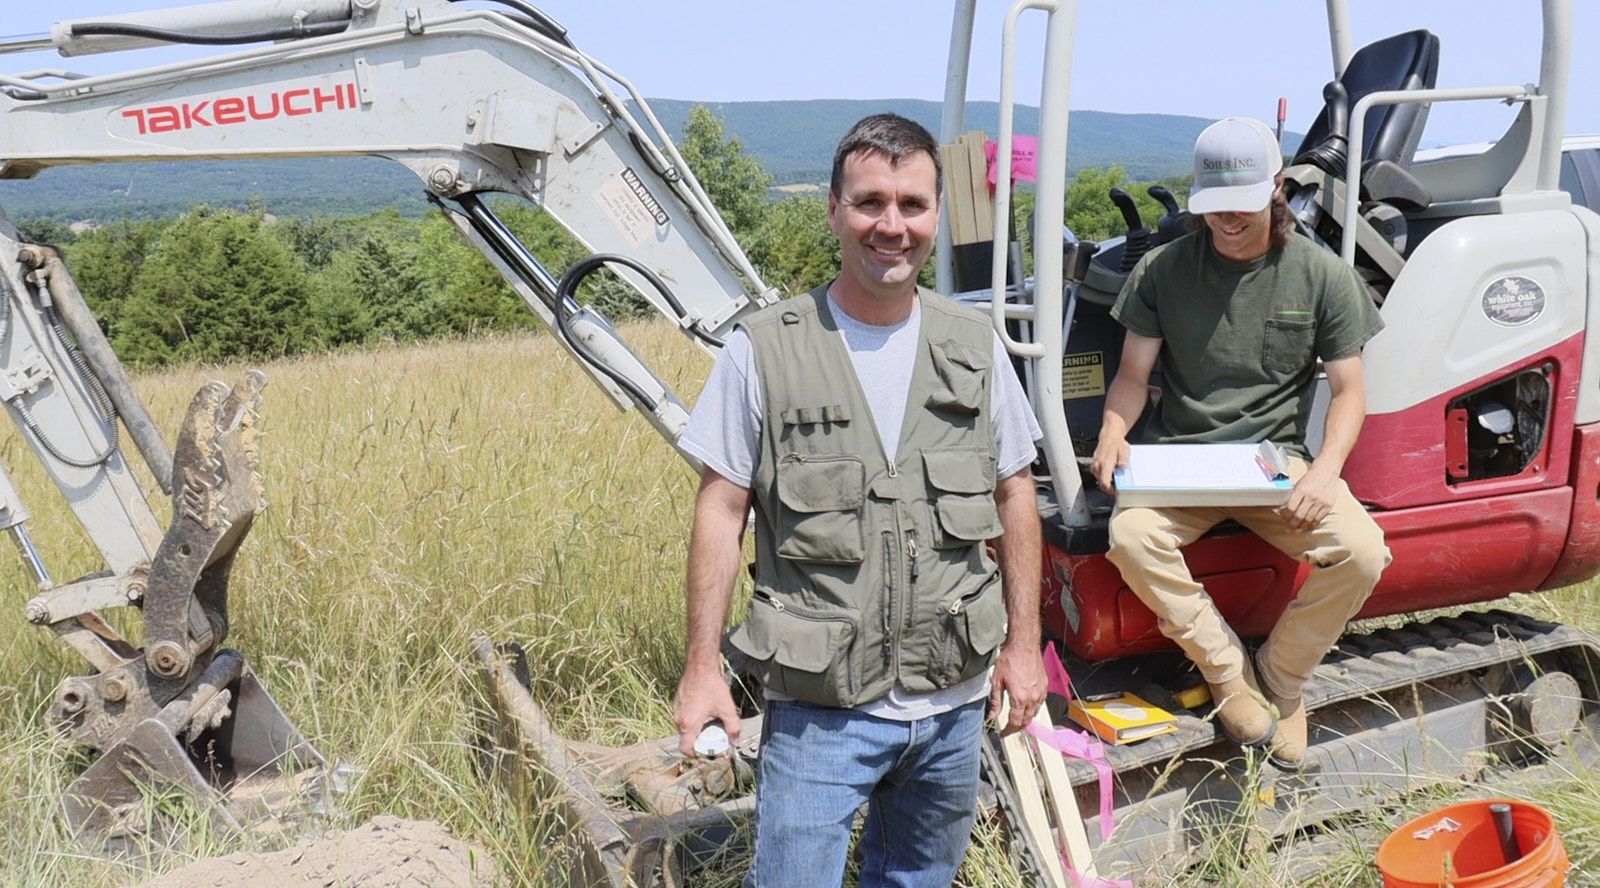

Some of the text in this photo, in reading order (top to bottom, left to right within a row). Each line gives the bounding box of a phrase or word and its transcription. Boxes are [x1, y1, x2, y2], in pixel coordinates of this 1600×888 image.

[624, 170, 667, 224] WARNING
[1487, 290, 1537, 305] white oak
[1063, 354, 1099, 367] RNING
